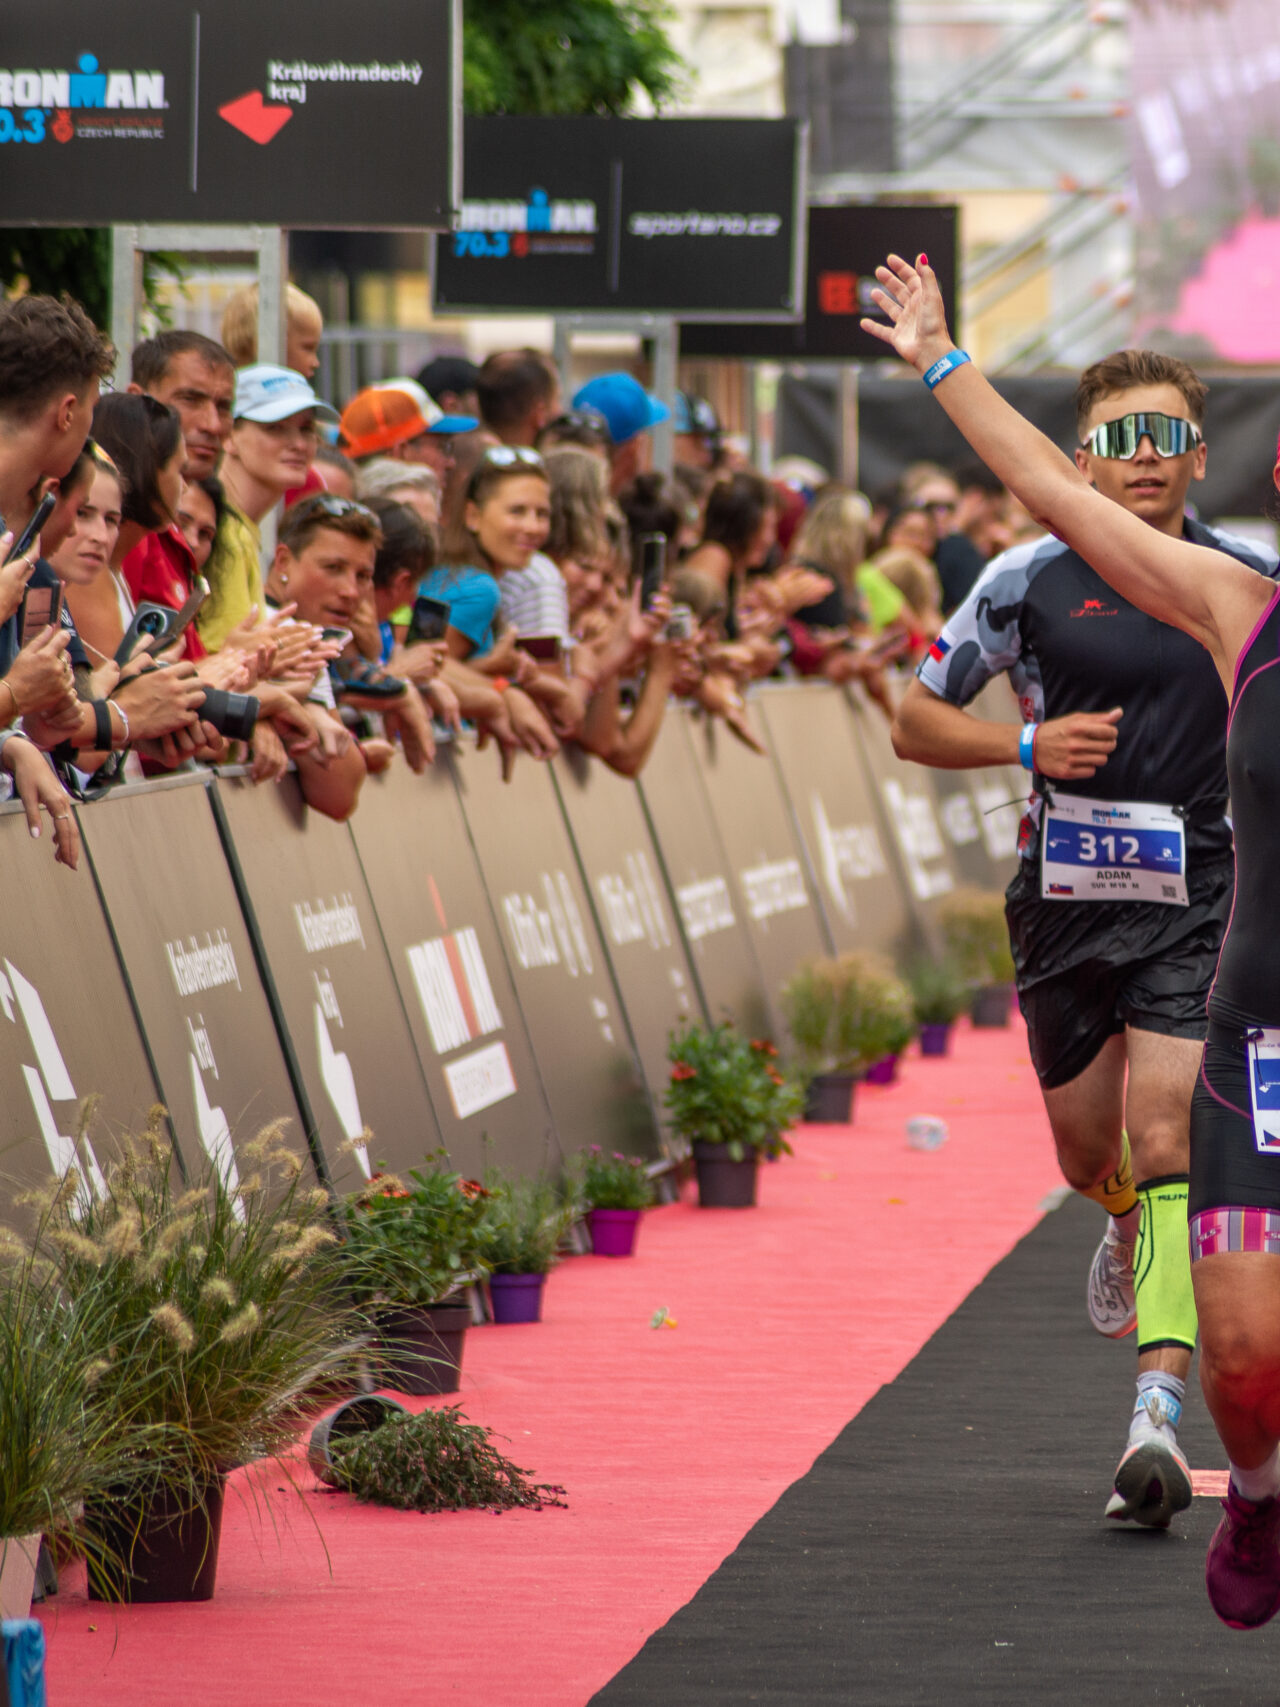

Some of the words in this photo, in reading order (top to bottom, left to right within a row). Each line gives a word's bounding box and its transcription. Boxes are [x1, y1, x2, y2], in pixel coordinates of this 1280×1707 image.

[269, 60, 422, 85] Královéhradecký
[269, 82, 306, 103] kraj
[77, 128, 112, 138] CZECH
[114, 128, 164, 139] REPUBLIC
[454, 231, 510, 257] 70.3
[1091, 807, 1131, 819] IRONMAN
[1078, 831, 1141, 864] 312
[1096, 870, 1132, 881] ADAM
